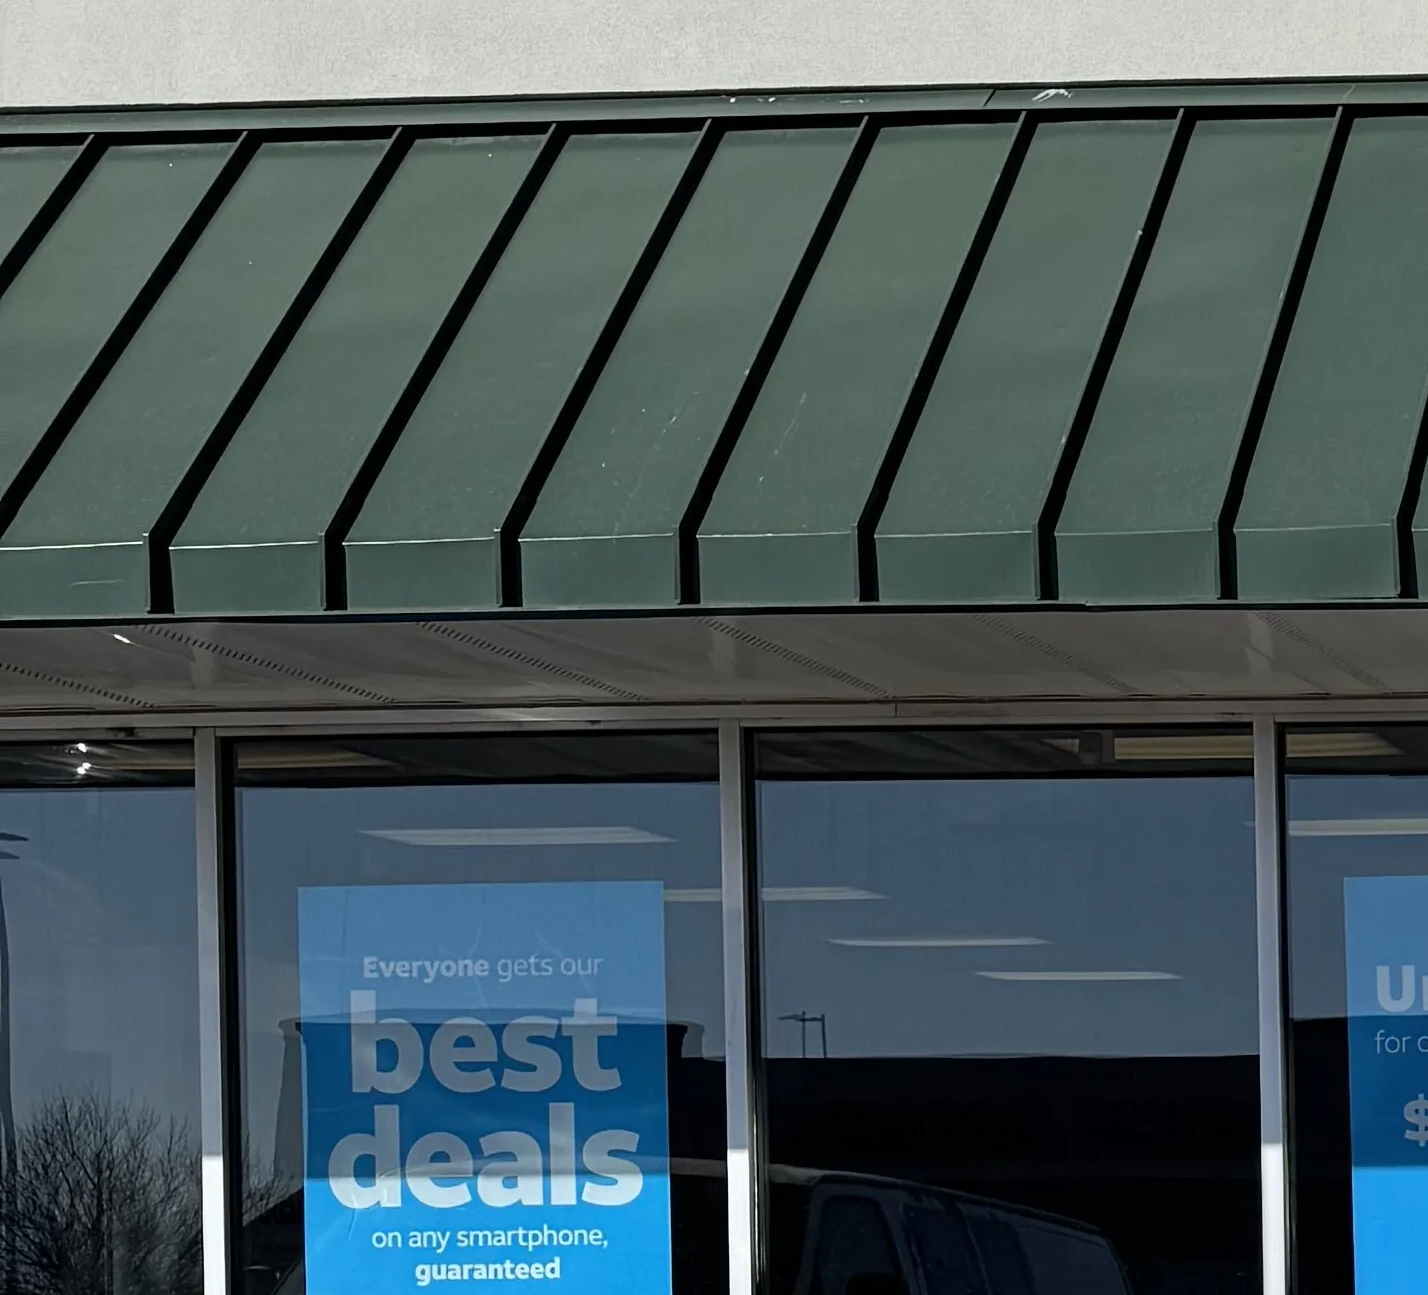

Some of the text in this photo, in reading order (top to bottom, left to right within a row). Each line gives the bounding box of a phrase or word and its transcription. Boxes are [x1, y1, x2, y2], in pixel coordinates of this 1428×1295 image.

[363, 956, 603, 985] Everyone gets our
[350, 989, 622, 1094] best
[1374, 1029, 1411, 1054] for
[328, 1102, 644, 1209] deals
[372, 1224, 609, 1254] on any smartphone,
[415, 1257, 561, 1286] guaranteed
